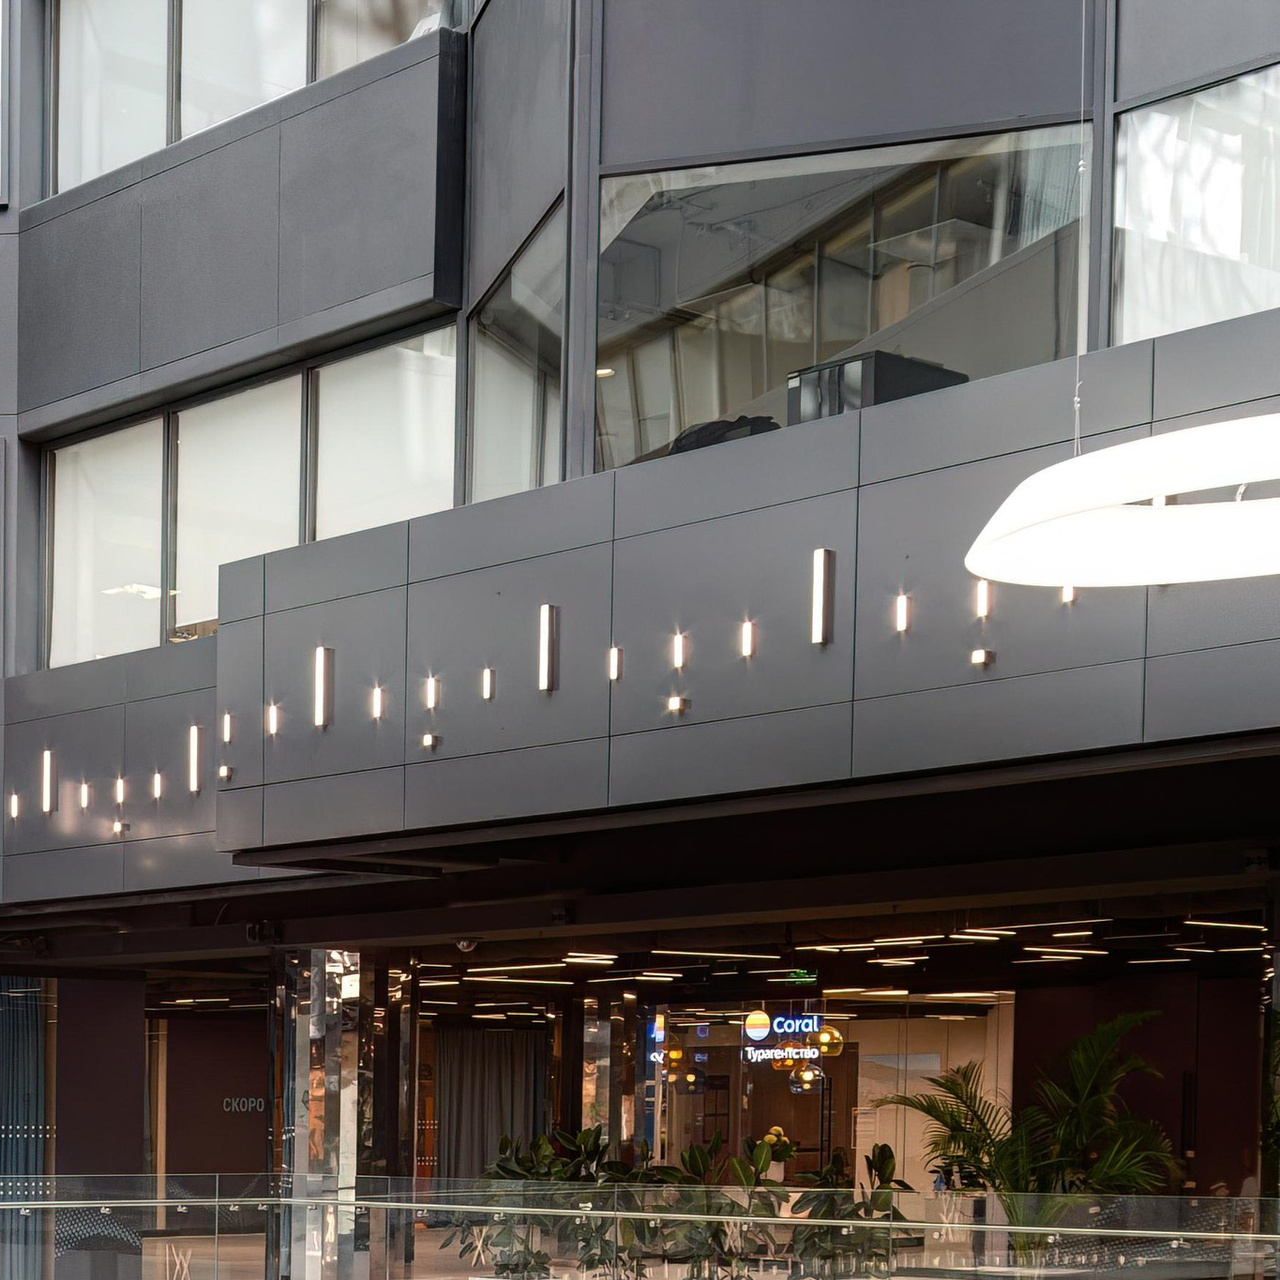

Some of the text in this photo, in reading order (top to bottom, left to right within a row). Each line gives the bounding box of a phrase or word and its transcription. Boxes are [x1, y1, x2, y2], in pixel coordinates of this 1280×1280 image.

[773, 1015, 819, 1033] Coral
[745, 1047, 819, 1062] Турагентство
[222, 1097, 265, 1112] СКОРО
